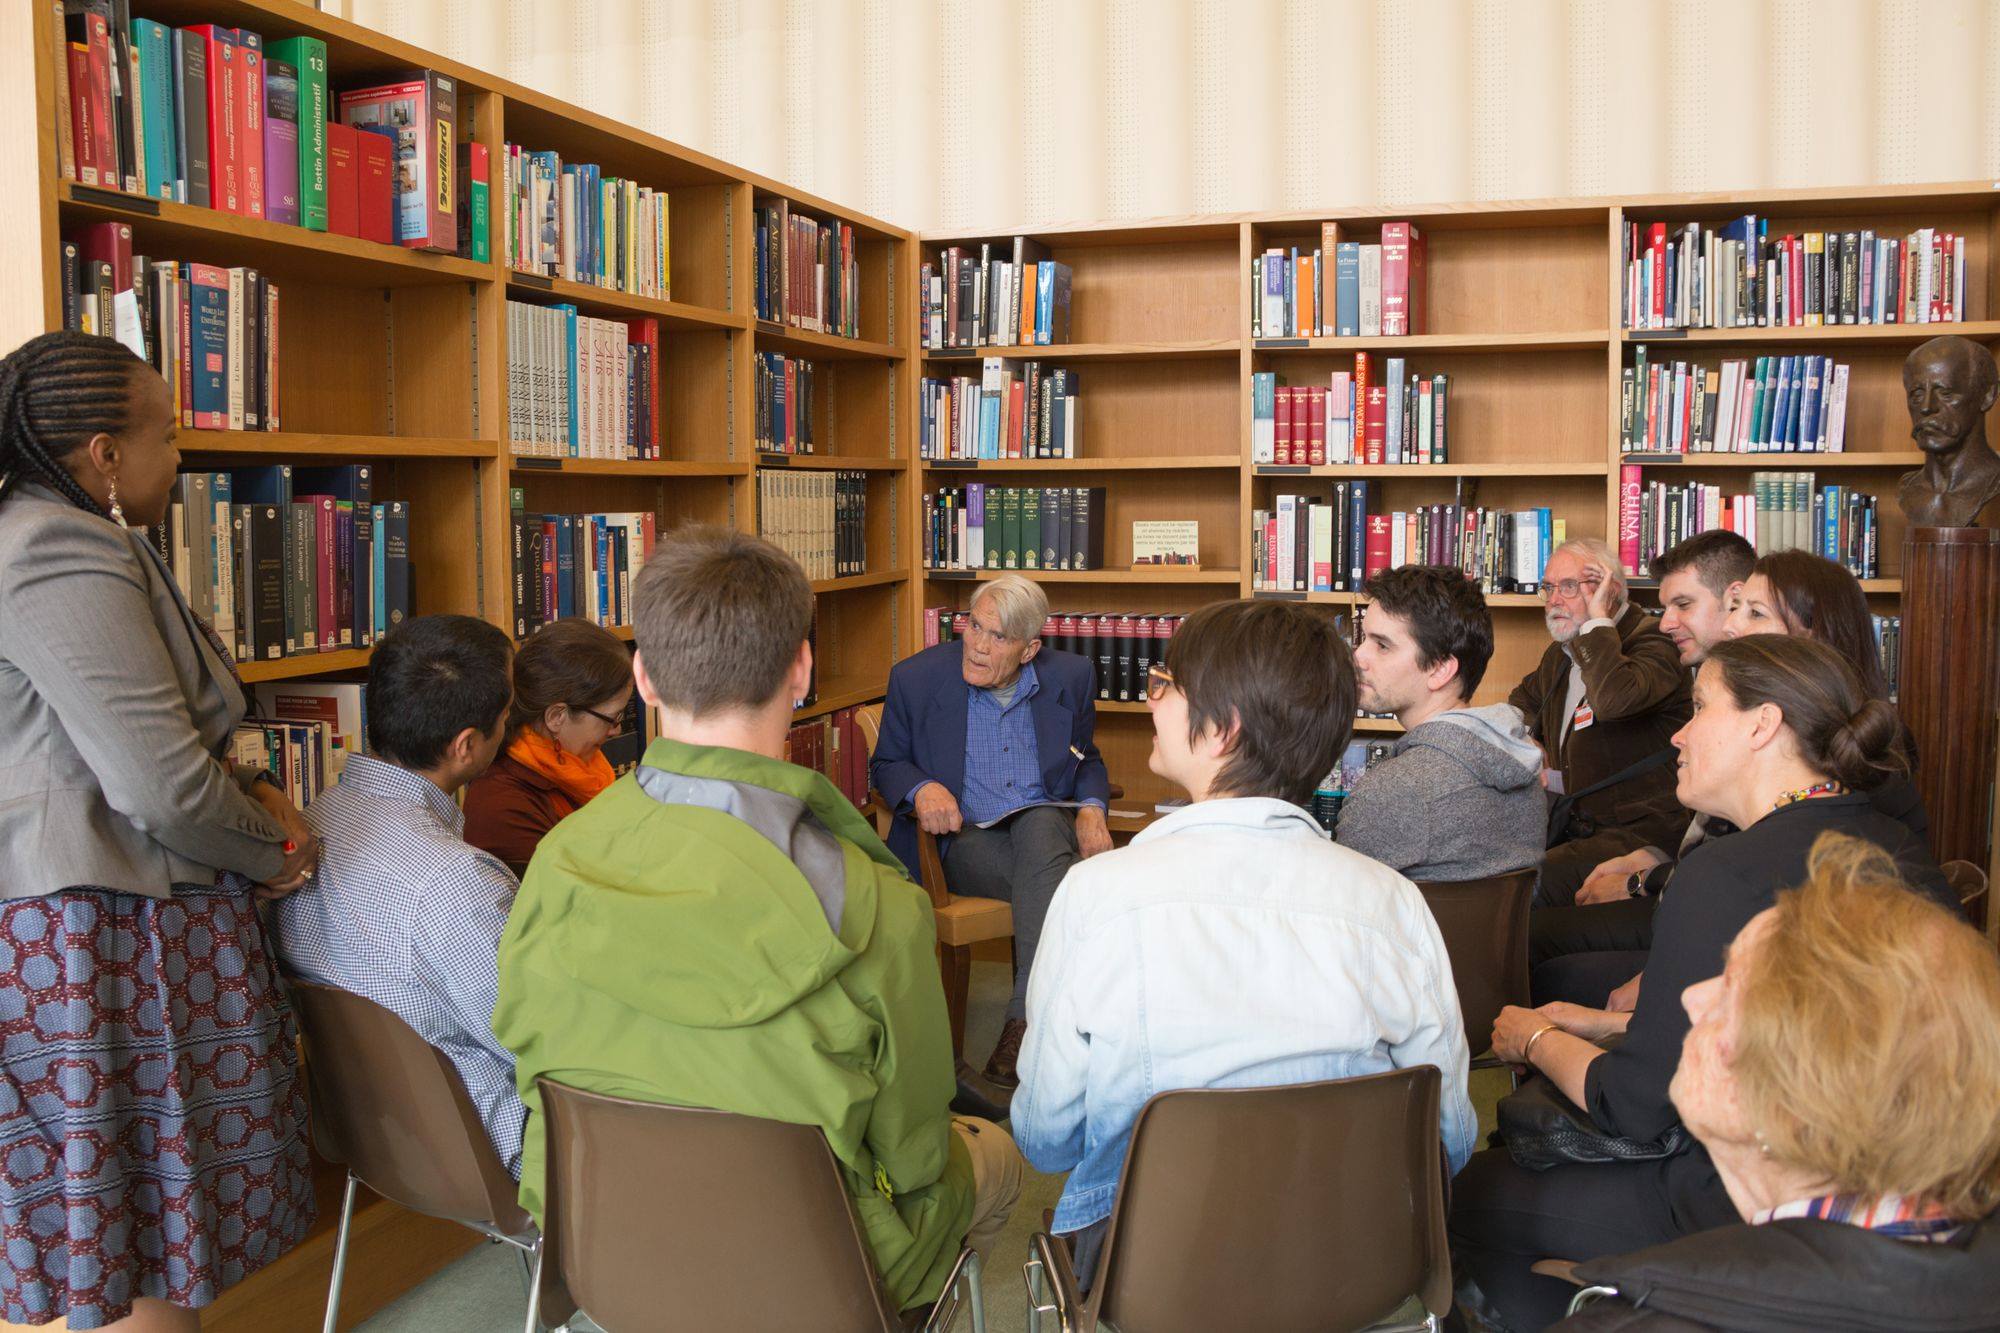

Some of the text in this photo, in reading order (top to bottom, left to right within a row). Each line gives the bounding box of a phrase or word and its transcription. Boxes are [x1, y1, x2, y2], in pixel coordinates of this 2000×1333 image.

[309, 57, 324, 72] 13
[310, 46, 324, 57] 20
[313, 82, 323, 191] Bottin Administratif
[476, 194, 484, 225] 2015
[593, 340, 605, 376] Arts
[605, 341, 616, 376] Arts
[617, 343, 626, 377] Arts
[1356, 376, 1364, 405] SPANISH
[581, 401, 590, 431] Century
[596, 403, 605, 432] Century
[607, 403, 615, 433] Century
[1356, 406, 1364, 437] WORLD
[514, 432, 518, 440] 2
[521, 432, 525, 440] 3
[1627, 483, 1640, 541] CHINA
[287, 562, 292, 571] OF
